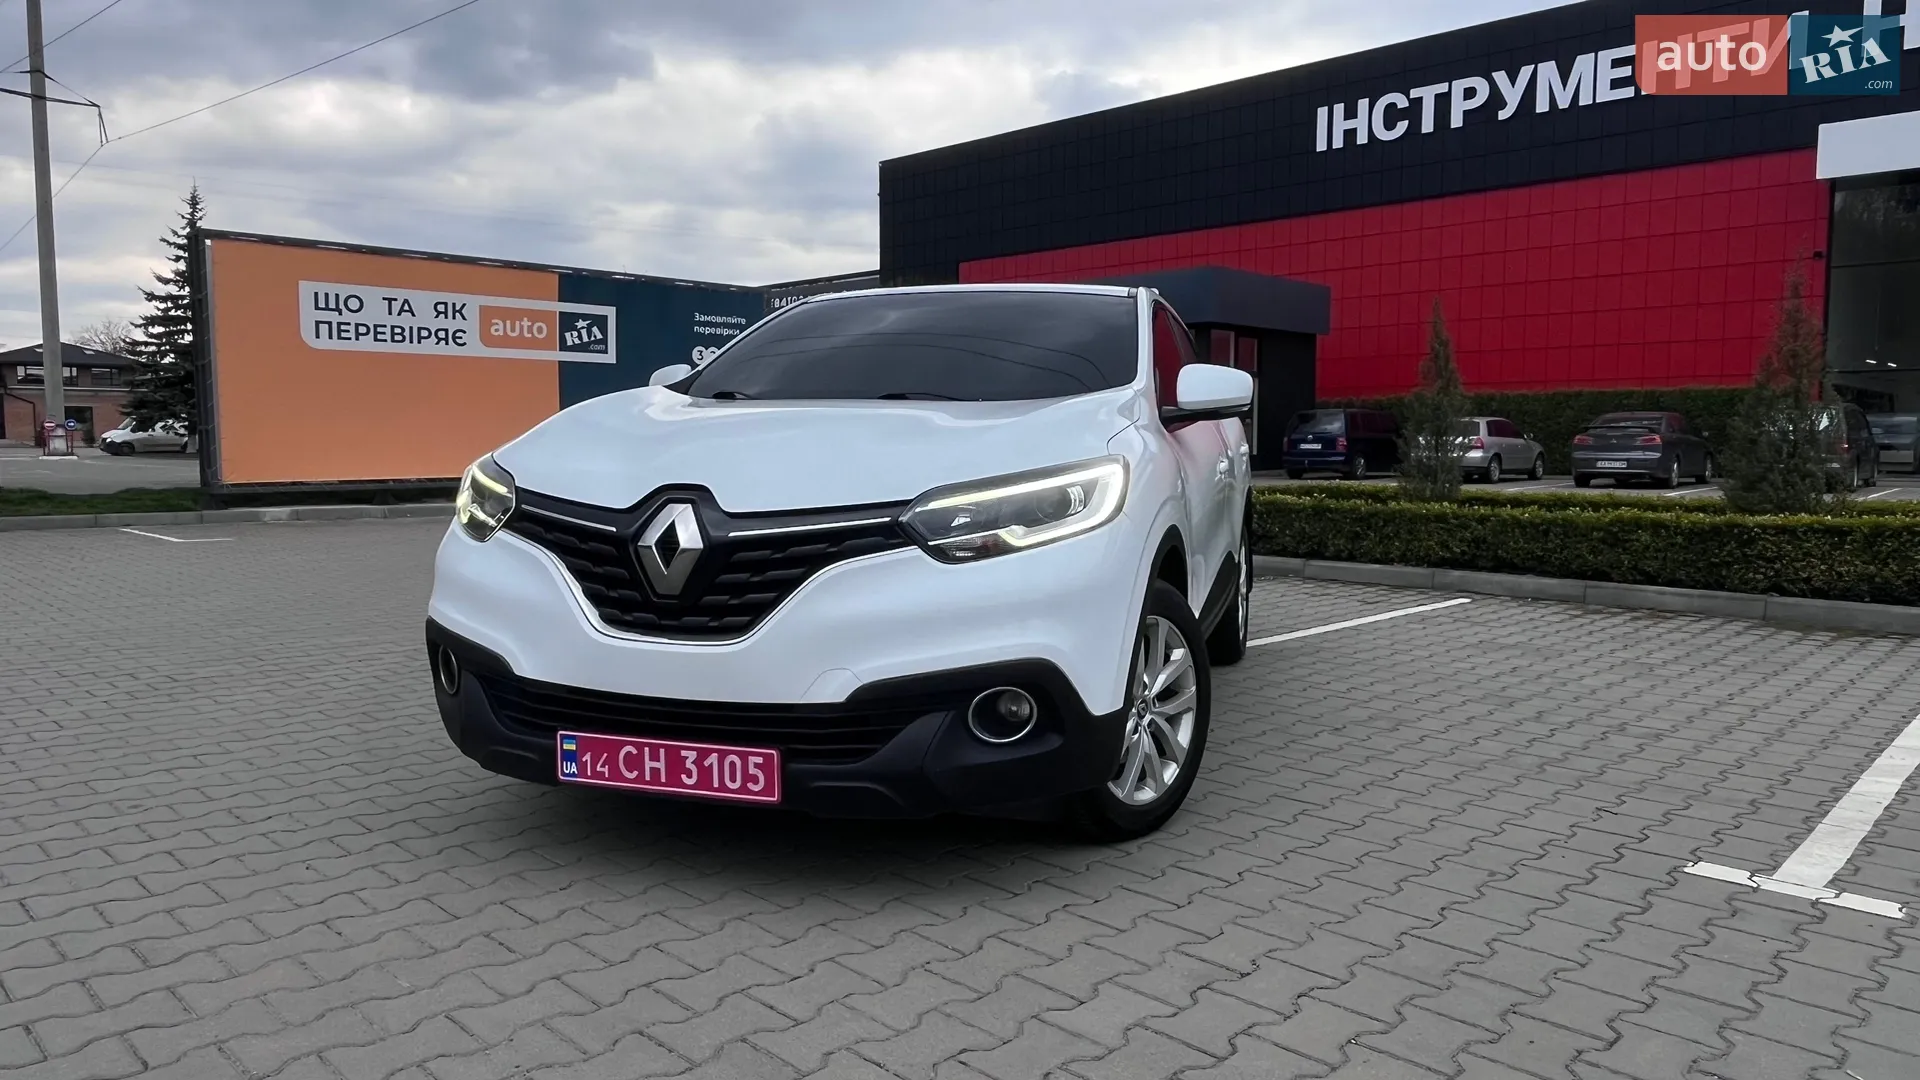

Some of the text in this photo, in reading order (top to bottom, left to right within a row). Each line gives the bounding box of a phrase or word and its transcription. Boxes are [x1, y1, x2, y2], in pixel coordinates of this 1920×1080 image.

[313, 291, 468, 321] ЩО ТА ЯК
[694, 312, 747, 325] Замовляйте
[314, 320, 468, 347] ПЕРЕВІРЯЄ
[490, 317, 604, 346] auto RIA
[694, 326, 740, 336] перевірки
[563, 761, 578, 774] UA
[582, 745, 766, 792] 14 CH 3105
